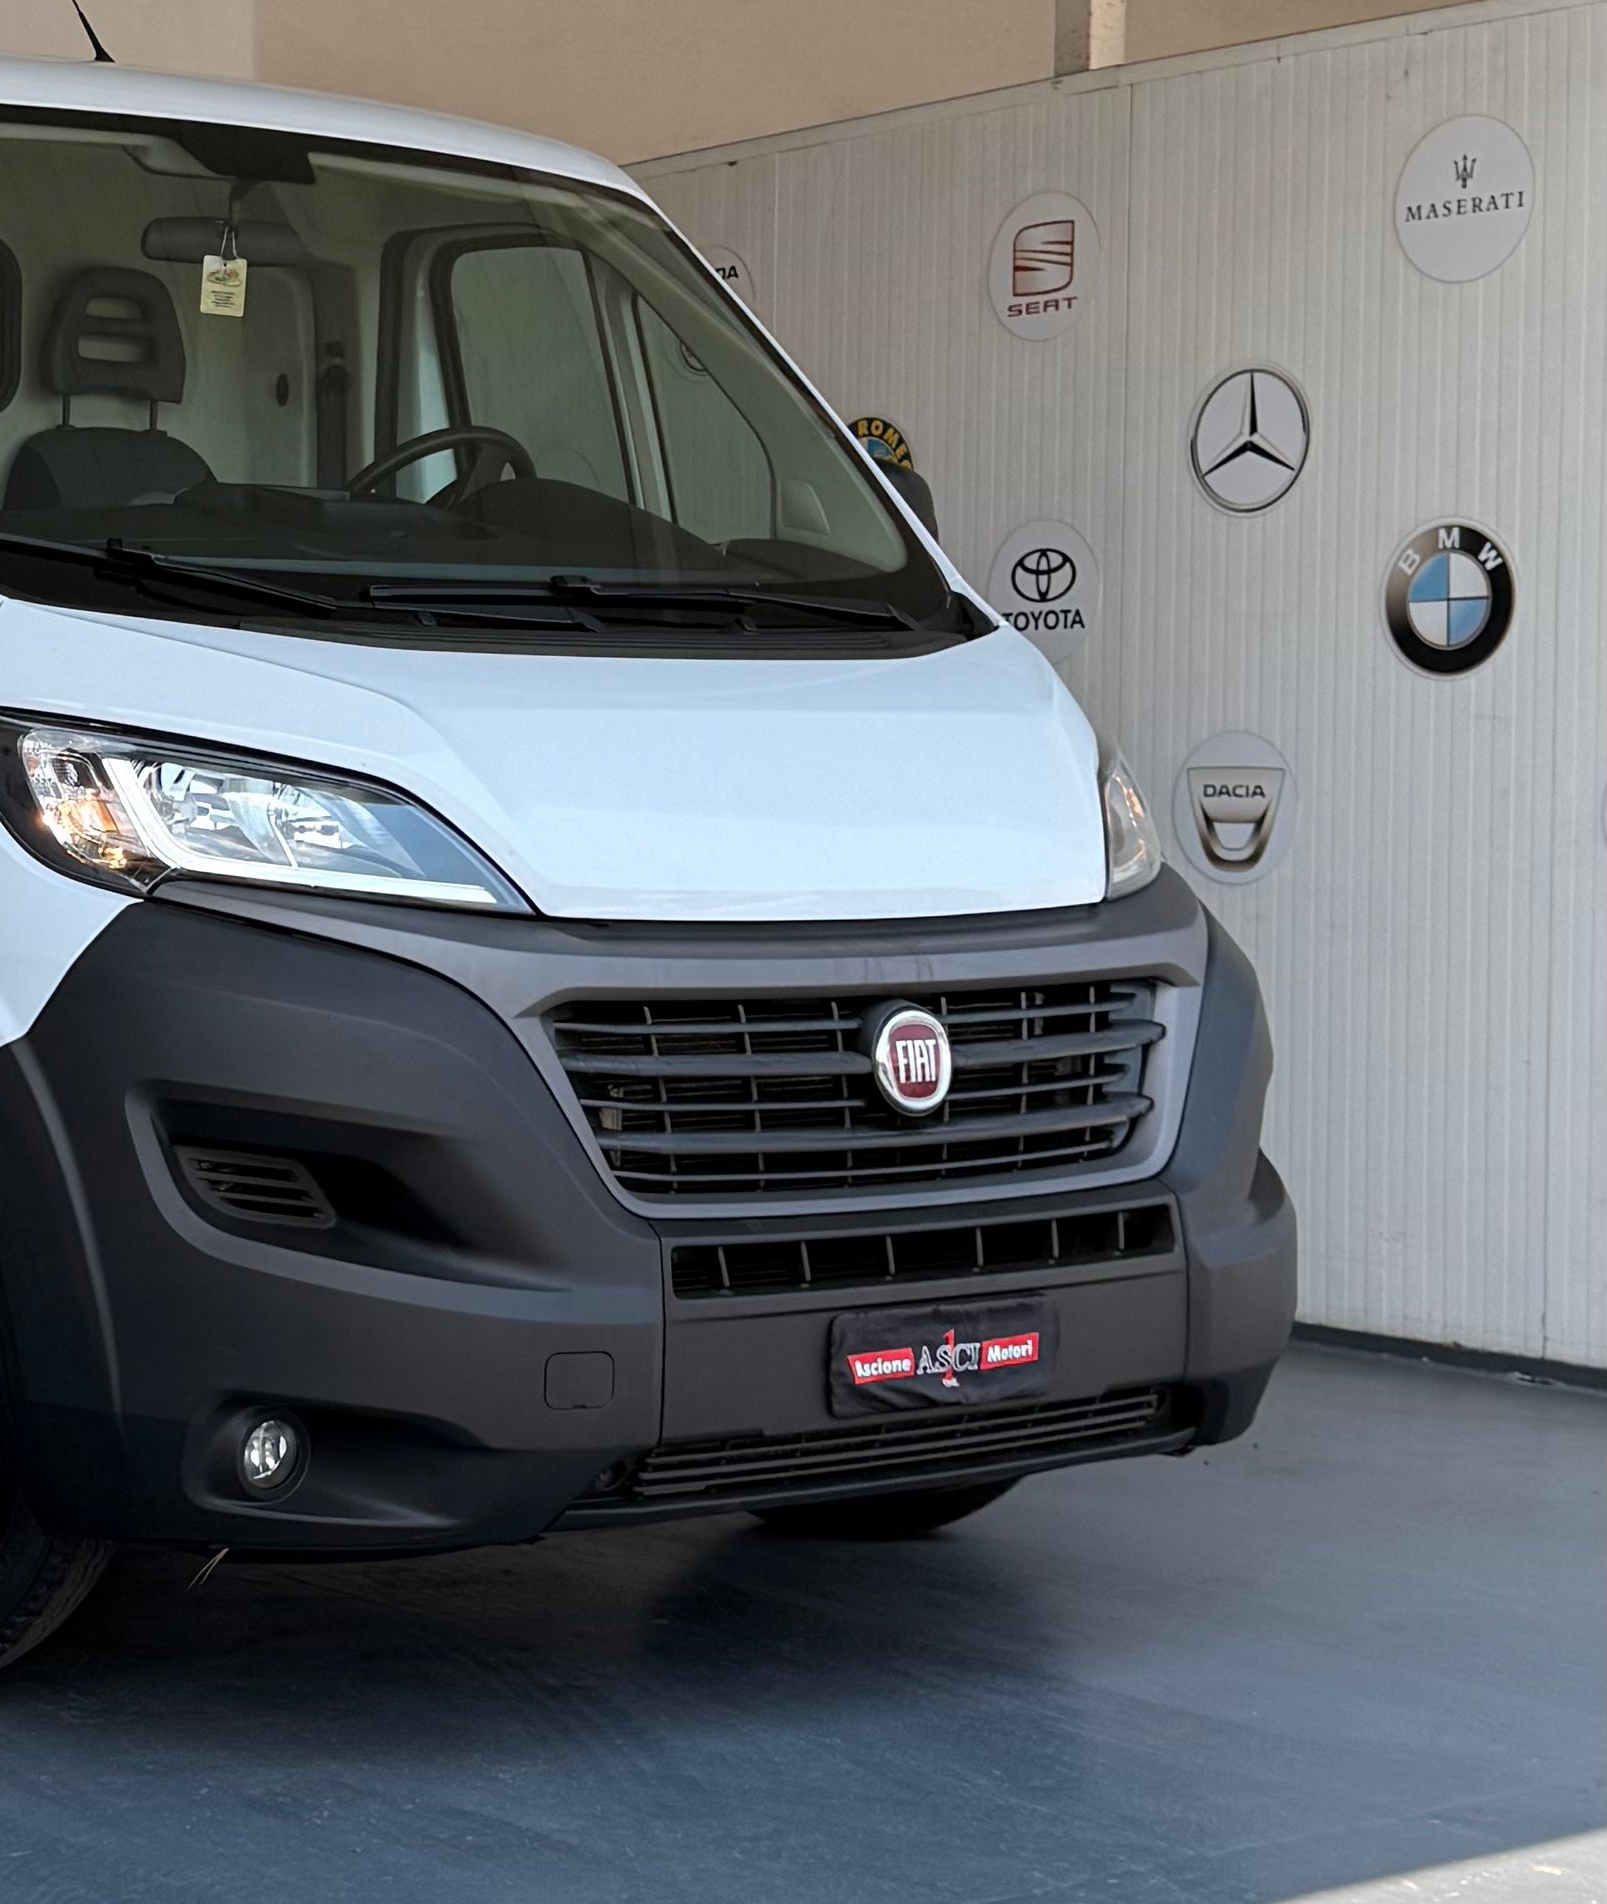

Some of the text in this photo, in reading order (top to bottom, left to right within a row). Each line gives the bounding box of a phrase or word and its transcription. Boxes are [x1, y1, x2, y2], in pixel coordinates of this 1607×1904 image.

[1404, 191, 1524, 222] MASERATI
[1007, 296, 1078, 318] SEAT
[1398, 527, 1503, 576] BMW
[1001, 608, 1085, 632] TOYOTA
[1203, 784, 1266, 798] DACIA
[895, 1039, 937, 1084] FIAT
[916, 1342, 981, 1375] ASCI
[987, 1340, 1033, 1363] Motori
